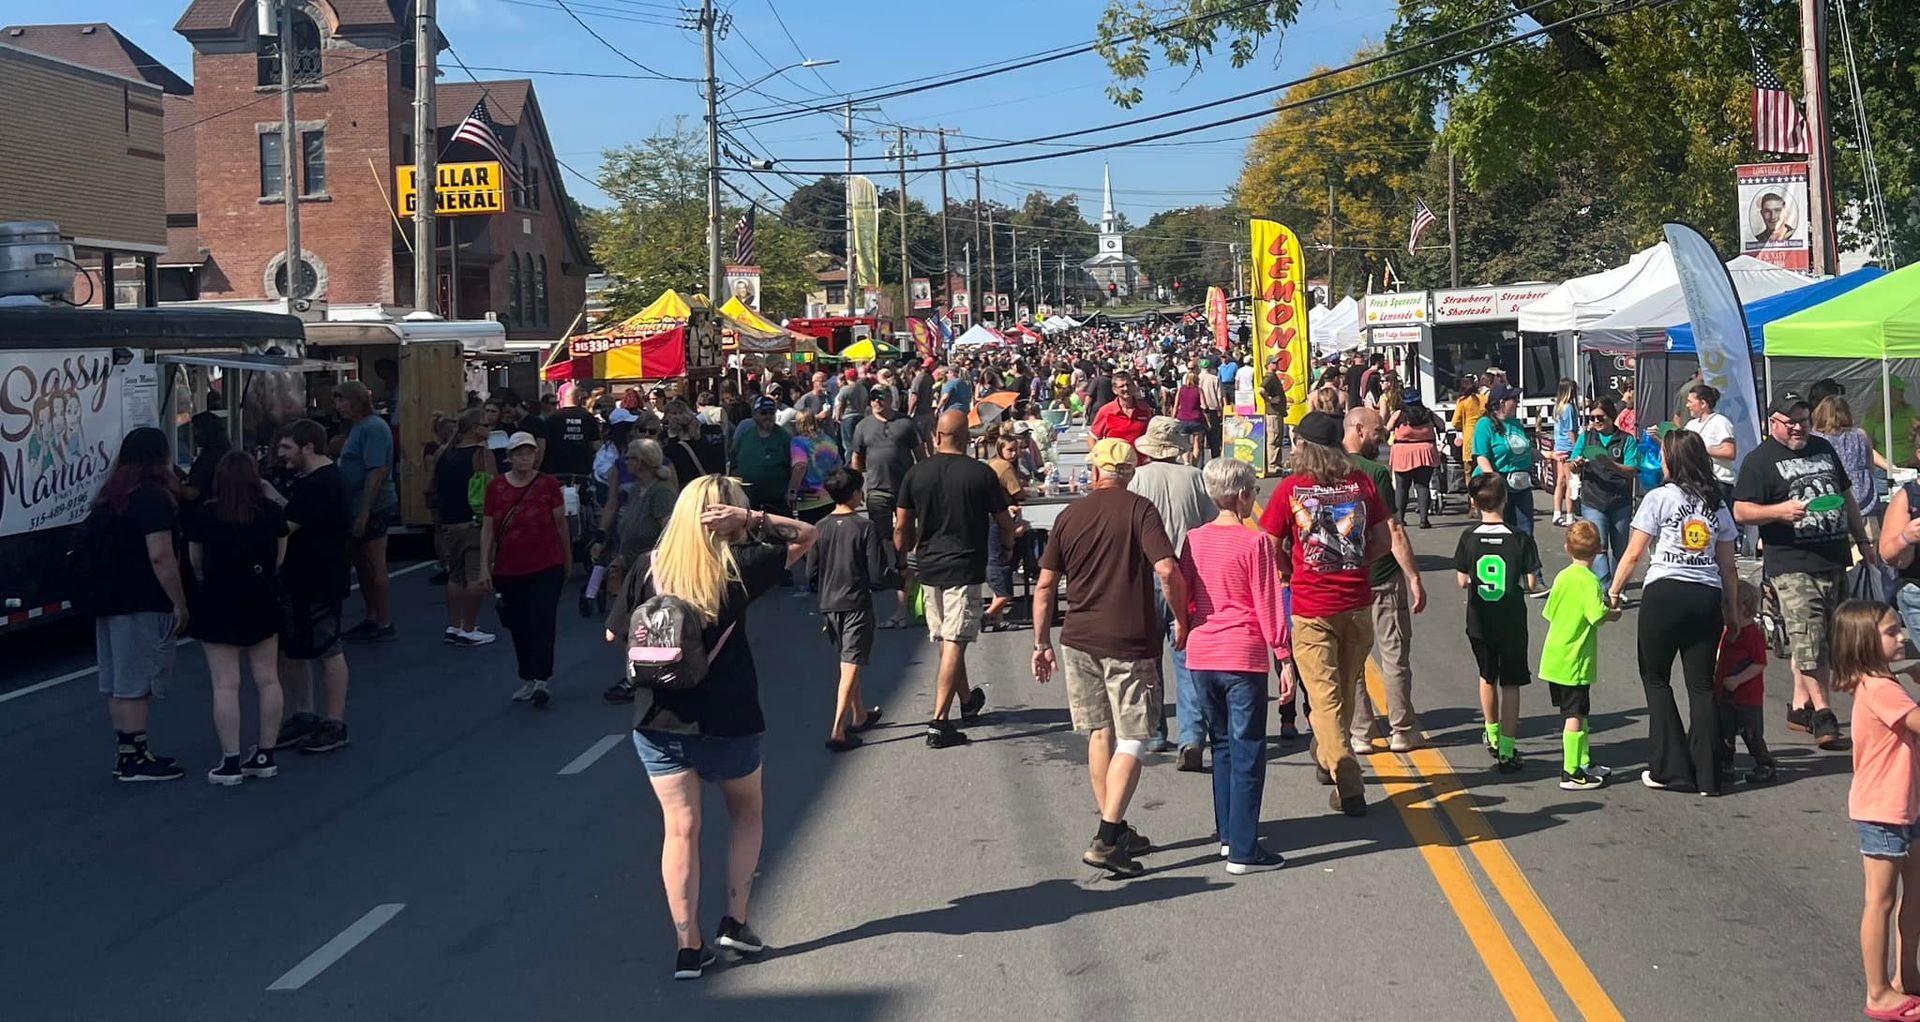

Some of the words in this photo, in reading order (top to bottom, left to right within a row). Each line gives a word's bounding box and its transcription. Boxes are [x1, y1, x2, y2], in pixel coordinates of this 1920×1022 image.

[410, 167, 490, 189] LLAR
[405, 189, 498, 212] GNERAL
[1369, 298, 1388, 308] Fresh
[1390, 295, 1423, 308] Squeezed
[1442, 293, 1493, 305] Strawberry
[1264, 233, 1297, 405] LEMONAD
[1379, 309, 1414, 321] Lemonade
[1446, 305, 1492, 317] Shortcake
[0, 354, 115, 443] Sassy
[0, 440, 112, 523] Mama's
[1476, 554, 1506, 602] 9
